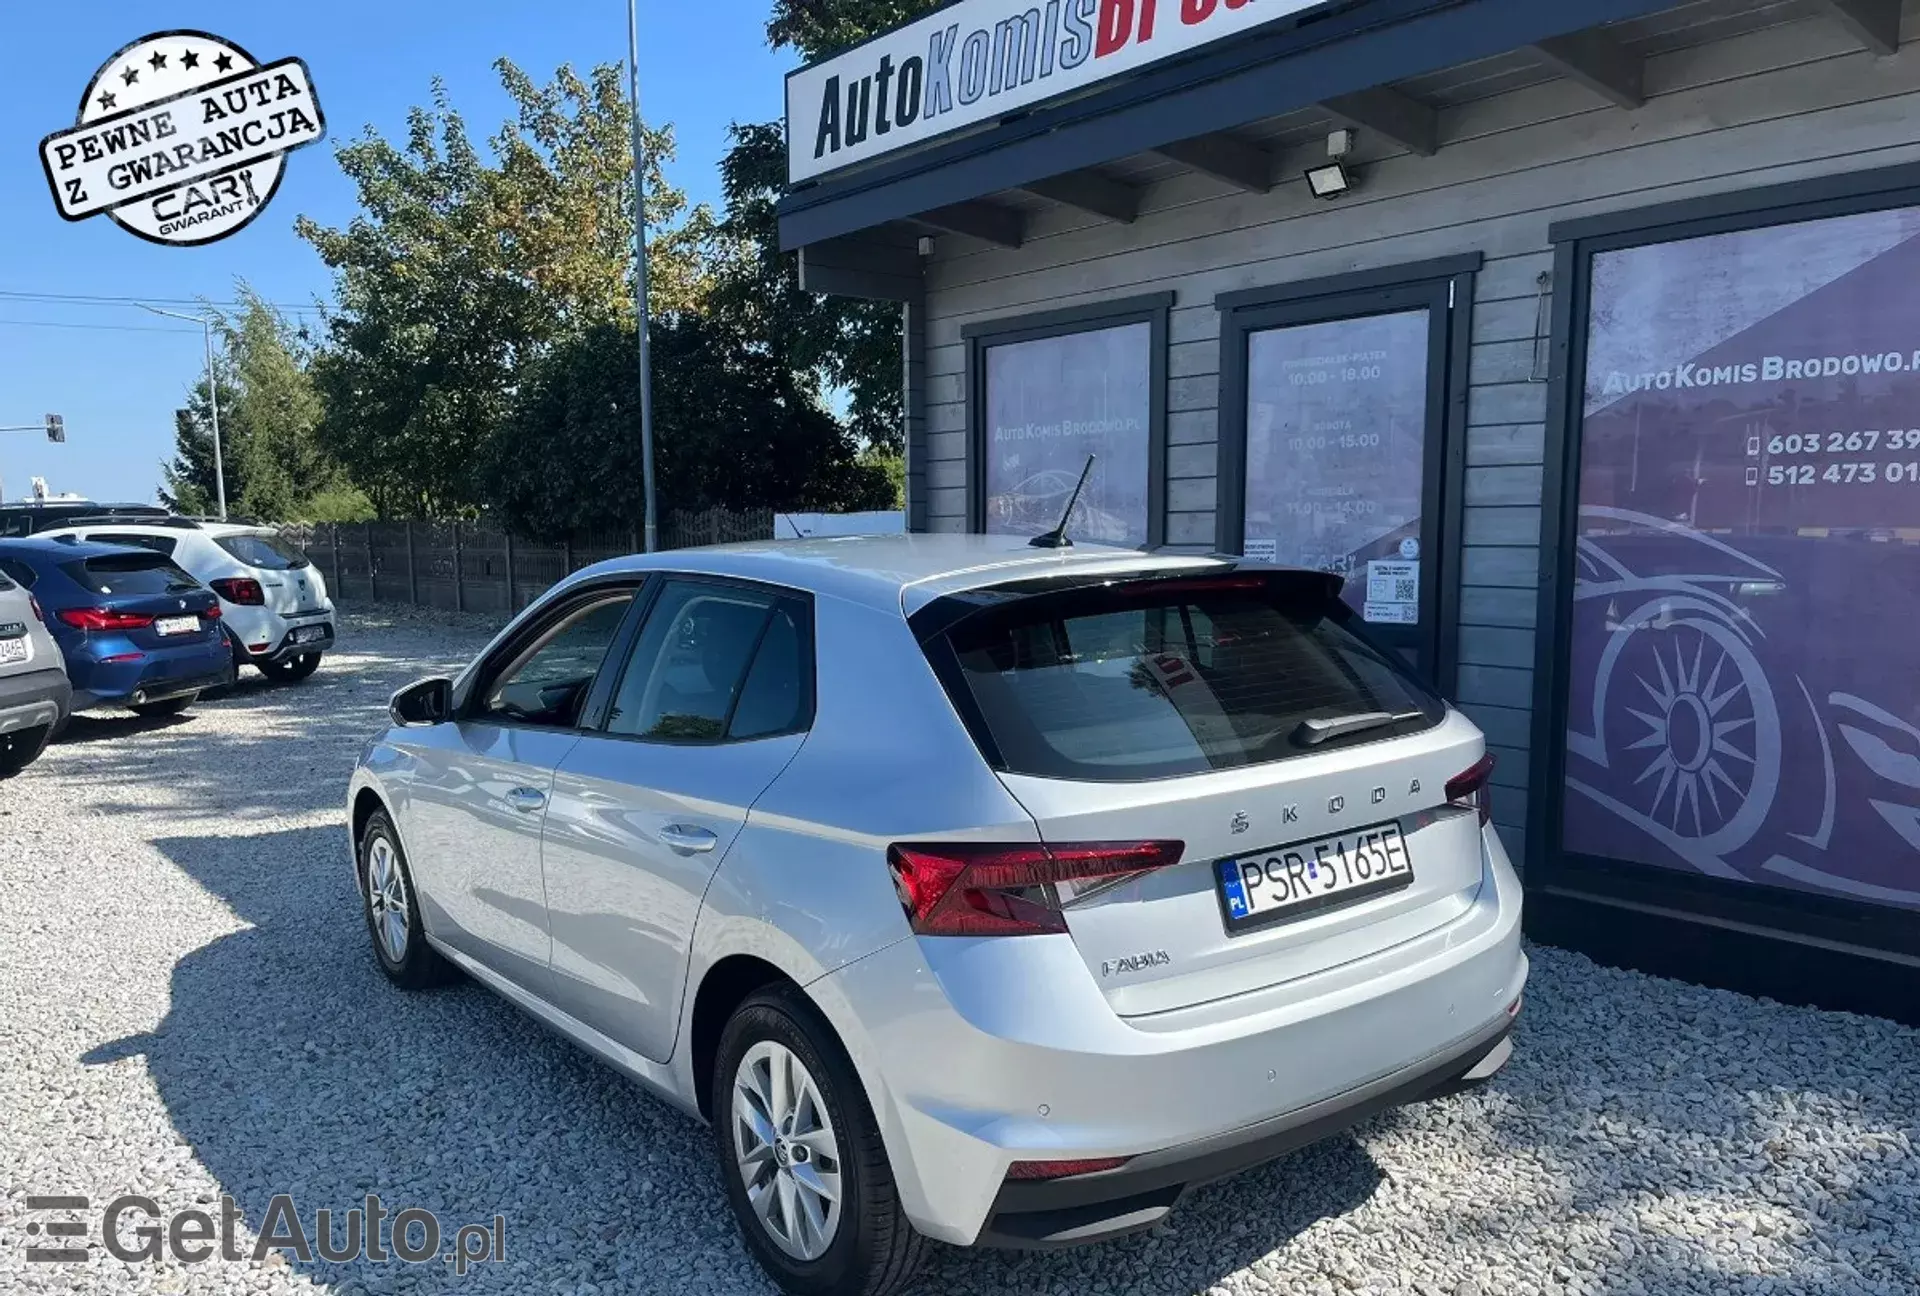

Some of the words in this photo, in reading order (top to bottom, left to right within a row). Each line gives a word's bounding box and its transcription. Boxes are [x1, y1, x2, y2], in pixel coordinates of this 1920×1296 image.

[1287, 370, 1328, 387] 10.00
[1341, 365, 1381, 383] 18.00
[1340, 433, 1380, 448] 15.00
[1767, 434, 1821, 454] 603
[1826, 431, 1880, 452] 267
[1767, 464, 1817, 485] 512
[1822, 462, 1876, 483] 473
[1230, 778, 1422, 836] ŠKODA
[1240, 851, 1313, 910] PSR
[1313, 828, 1406, 890] 5165E
[1230, 895, 1245, 910] PL
[1101, 949, 1171, 977] FABIA
